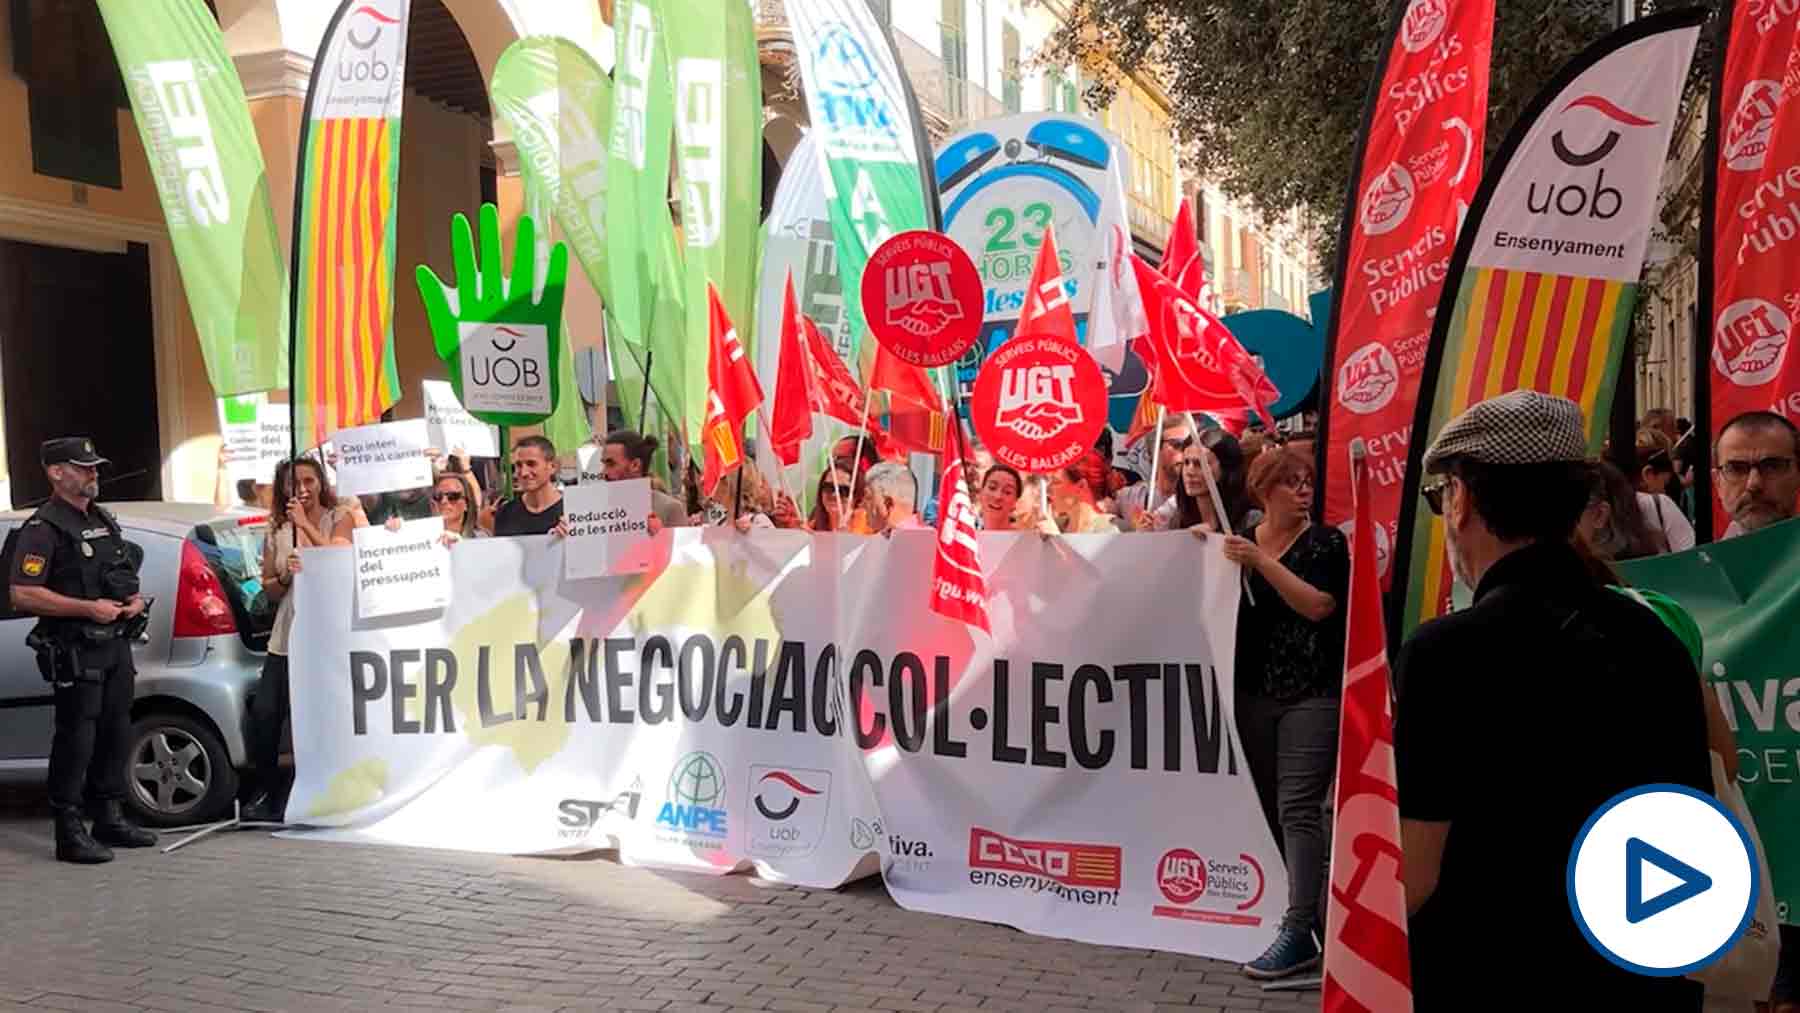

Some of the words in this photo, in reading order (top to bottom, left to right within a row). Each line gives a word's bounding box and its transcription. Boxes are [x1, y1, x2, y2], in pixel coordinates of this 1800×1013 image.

[338, 49, 390, 83] uob
[1526, 168, 1623, 219] uob
[985, 201, 1054, 253] 23
[1494, 231, 1625, 259] Ensenyament
[884, 261, 954, 309] UGT
[471, 355, 541, 388] UOB
[1000, 364, 1076, 410] UGT
[568, 507, 627, 523] Reducció
[568, 525, 585, 537] de
[587, 523, 607, 535] les
[359, 539, 433, 559] Increment
[360, 559, 384, 574] del
[361, 566, 441, 592] pressupost
[350, 647, 459, 736] PER
[478, 642, 549, 729] LA
[564, 634, 846, 737] NEGOCIAC
[849, 648, 1241, 776] COL·LECTIV
[656, 800, 729, 834] ANPE
[1207, 858, 1249, 876] Serveis
[1207, 875, 1249, 892] Públics
